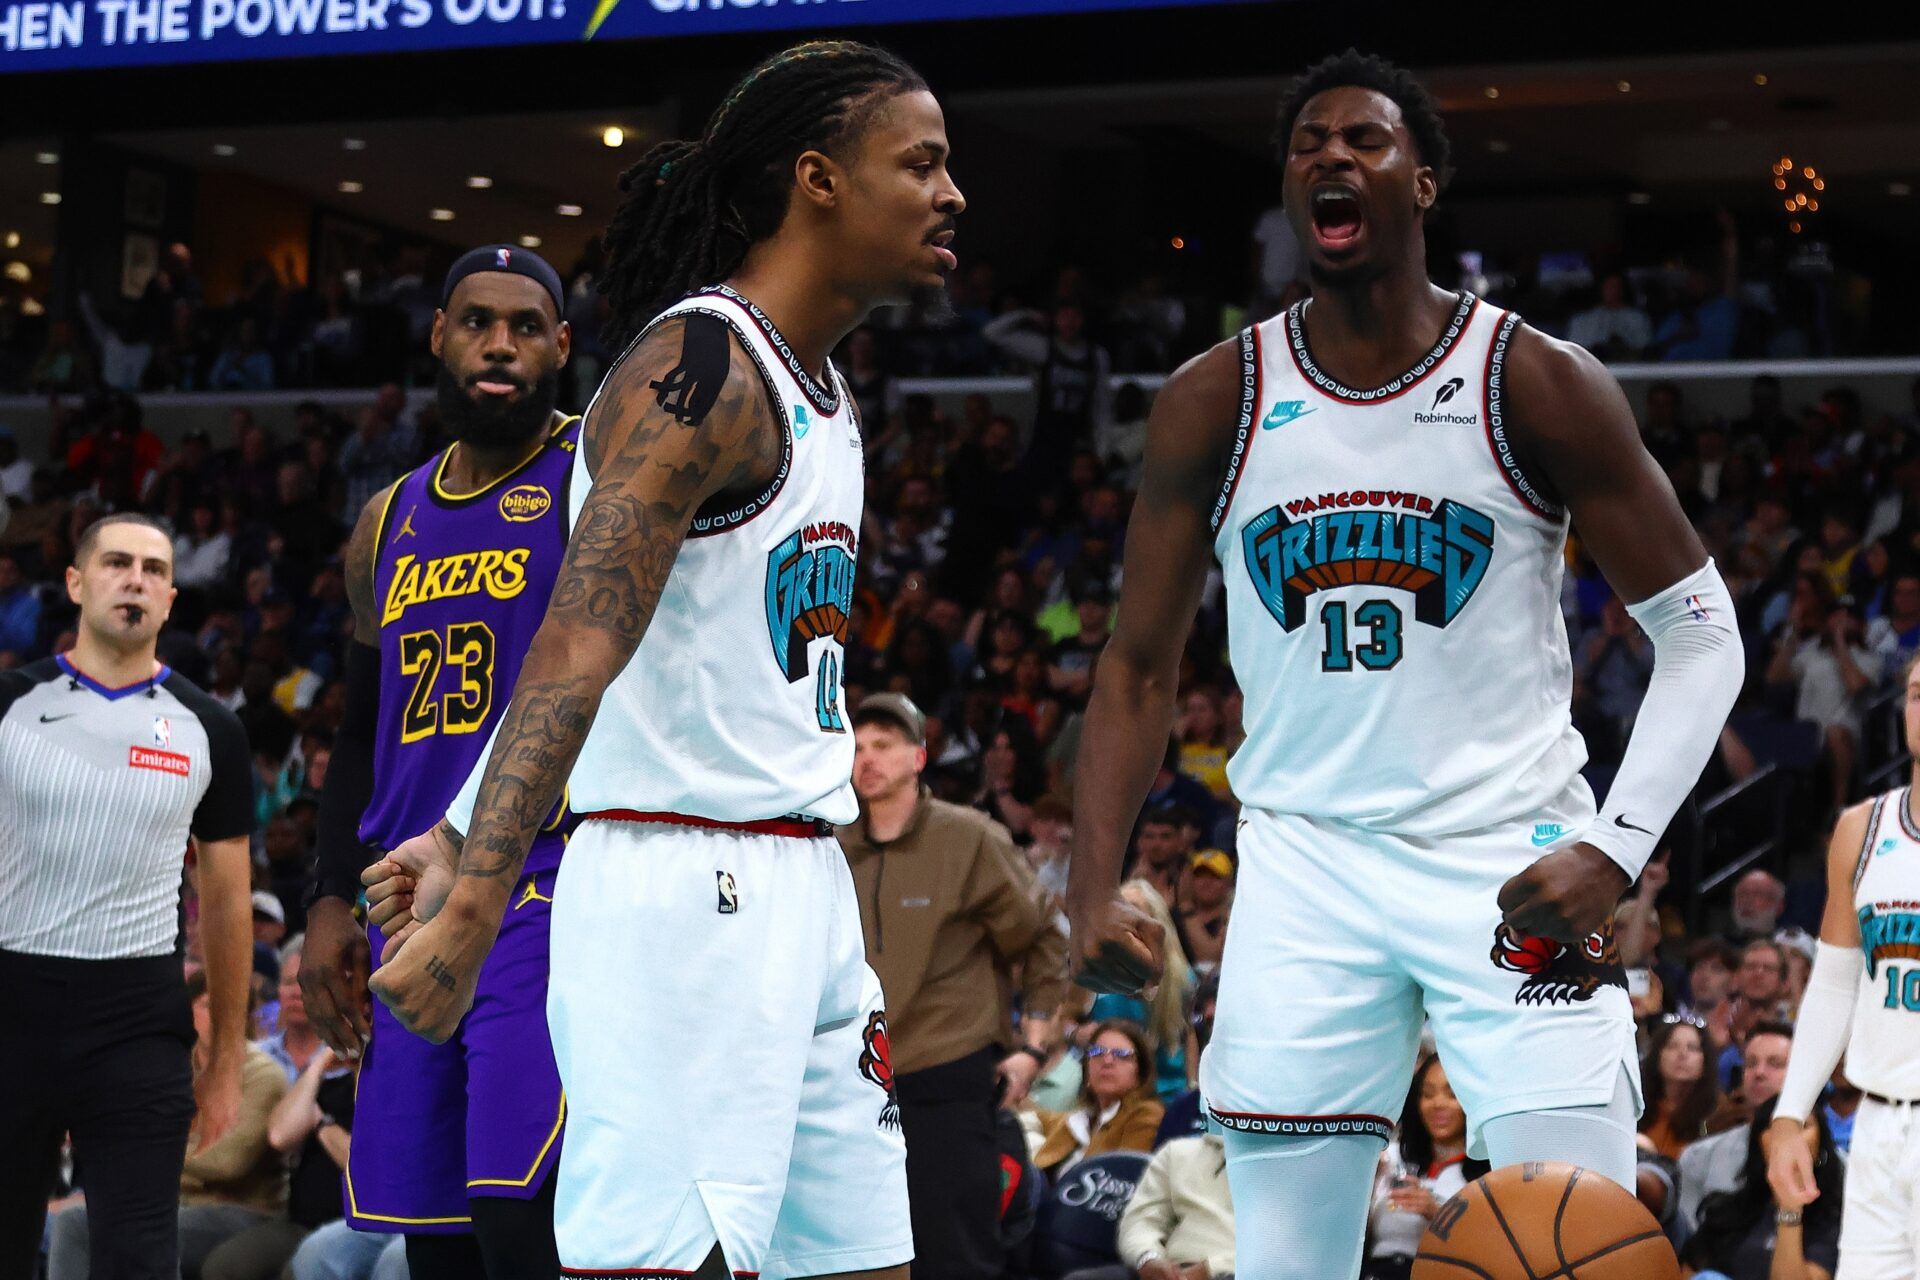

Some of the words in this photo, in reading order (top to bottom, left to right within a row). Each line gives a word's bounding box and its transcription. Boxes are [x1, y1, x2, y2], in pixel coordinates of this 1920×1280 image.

[95, 0, 191, 46] THE
[201, 0, 433, 41] POWER'S
[1413, 412, 1478, 425] Robinhood
[504, 494, 548, 512] bibigo
[1285, 490, 1435, 518] VANCOUVER
[381, 548, 531, 628] LAKERS
[1241, 498, 1495, 634] GRIZZLIES
[1320, 599, 1404, 673] 13
[400, 620, 496, 744] 23
[131, 751, 190, 772] Emirates
[424, 954, 457, 993] Him
[1883, 966, 1920, 1013] 10
